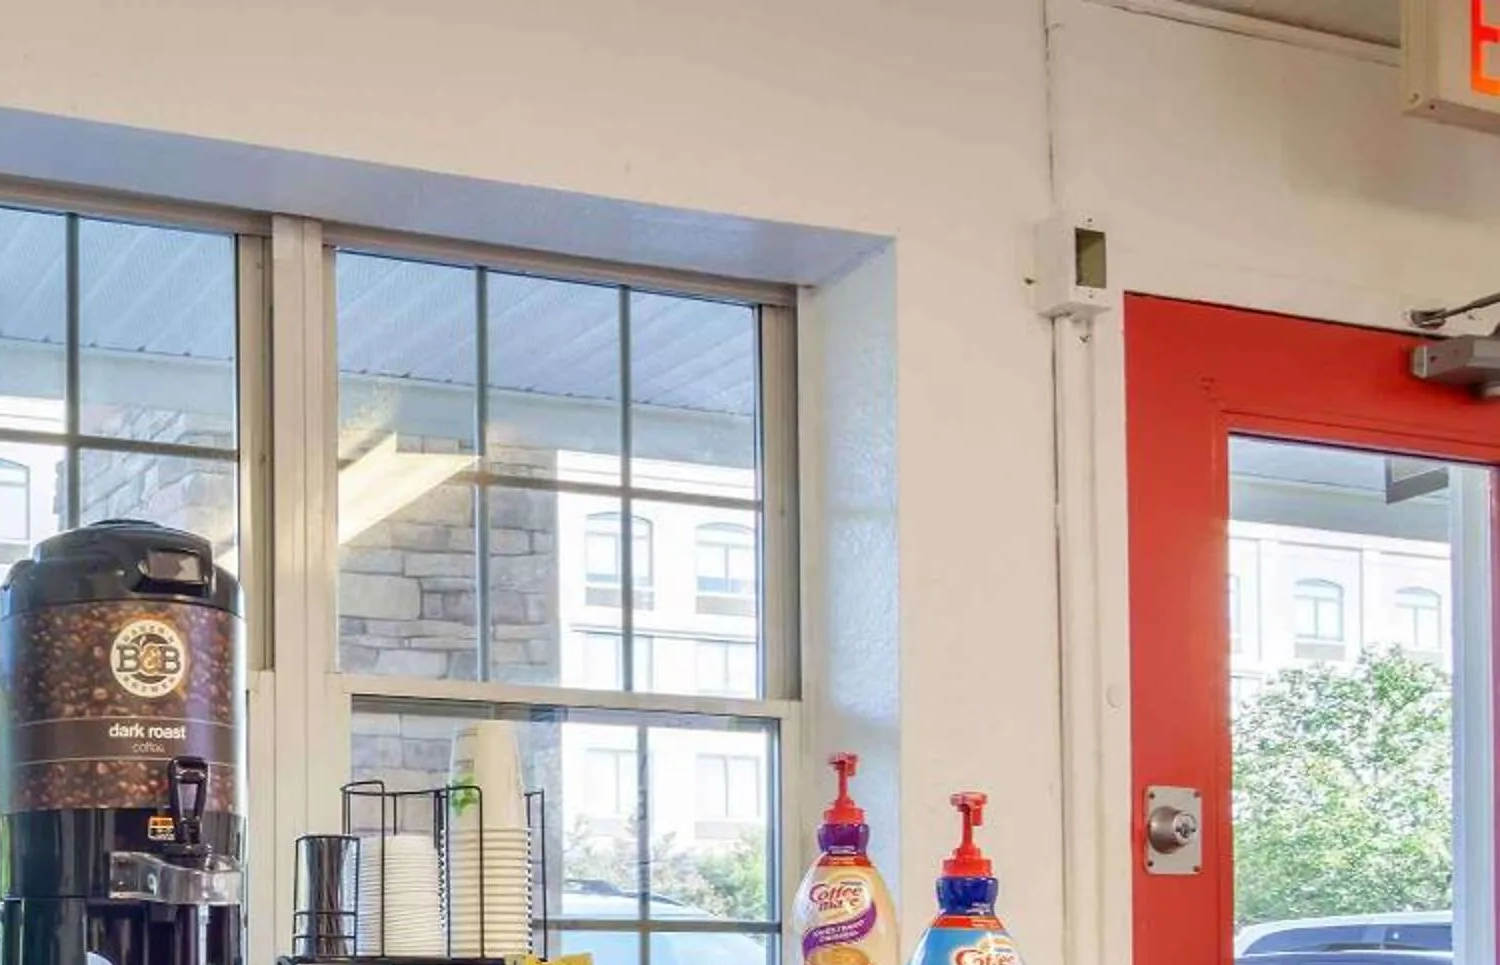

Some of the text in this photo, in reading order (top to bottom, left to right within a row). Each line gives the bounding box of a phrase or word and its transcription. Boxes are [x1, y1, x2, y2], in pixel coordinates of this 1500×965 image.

[108, 722, 187, 740] dark roast
[818, 897, 860, 912] mae
